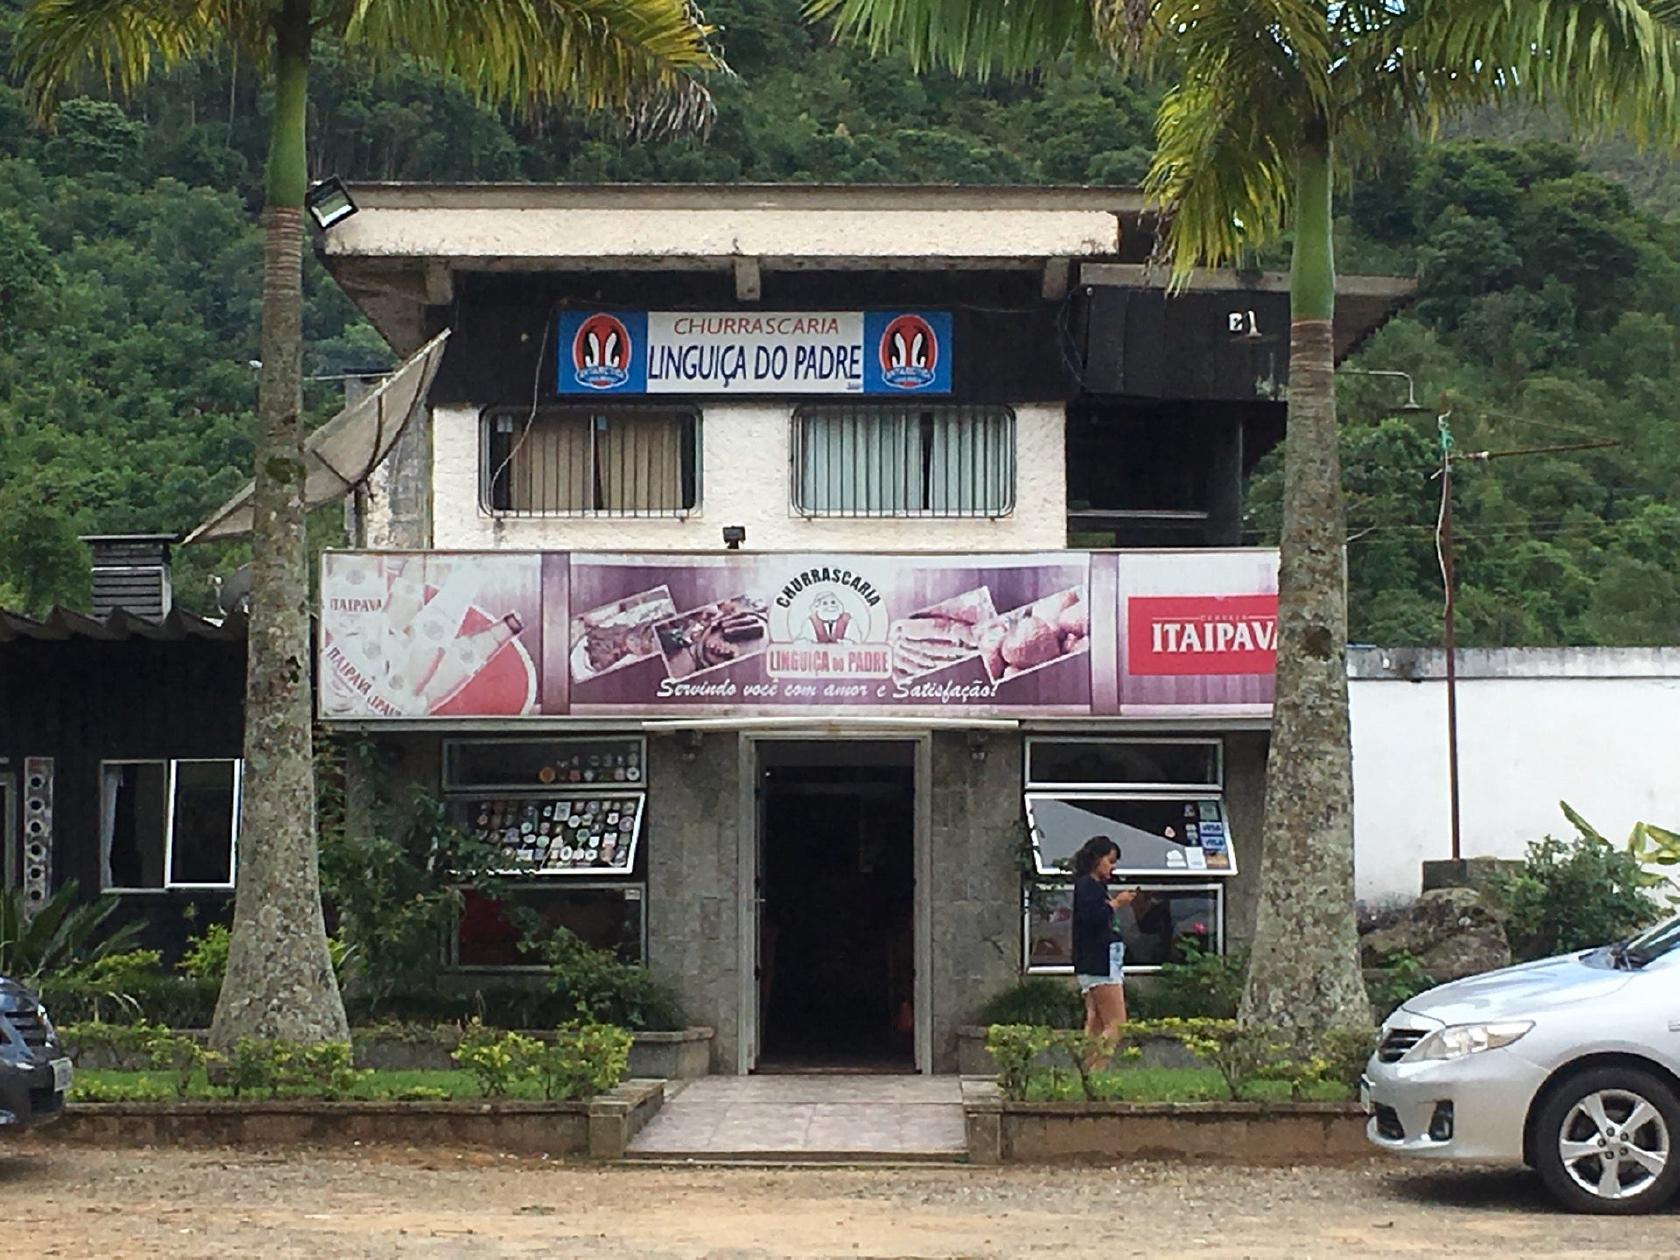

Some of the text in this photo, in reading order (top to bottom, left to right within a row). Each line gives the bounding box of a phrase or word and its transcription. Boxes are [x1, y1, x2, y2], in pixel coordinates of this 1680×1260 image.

[674, 317, 839, 335] CHURRASCARIA
[647, 344, 862, 388] LINGUIÇA DO PADRE
[776, 567, 881, 609] CHURRASCARIA
[848, 650, 889, 673] PADRE
[656, 678, 1000, 703] Servindo você com amor e Satisfação!
